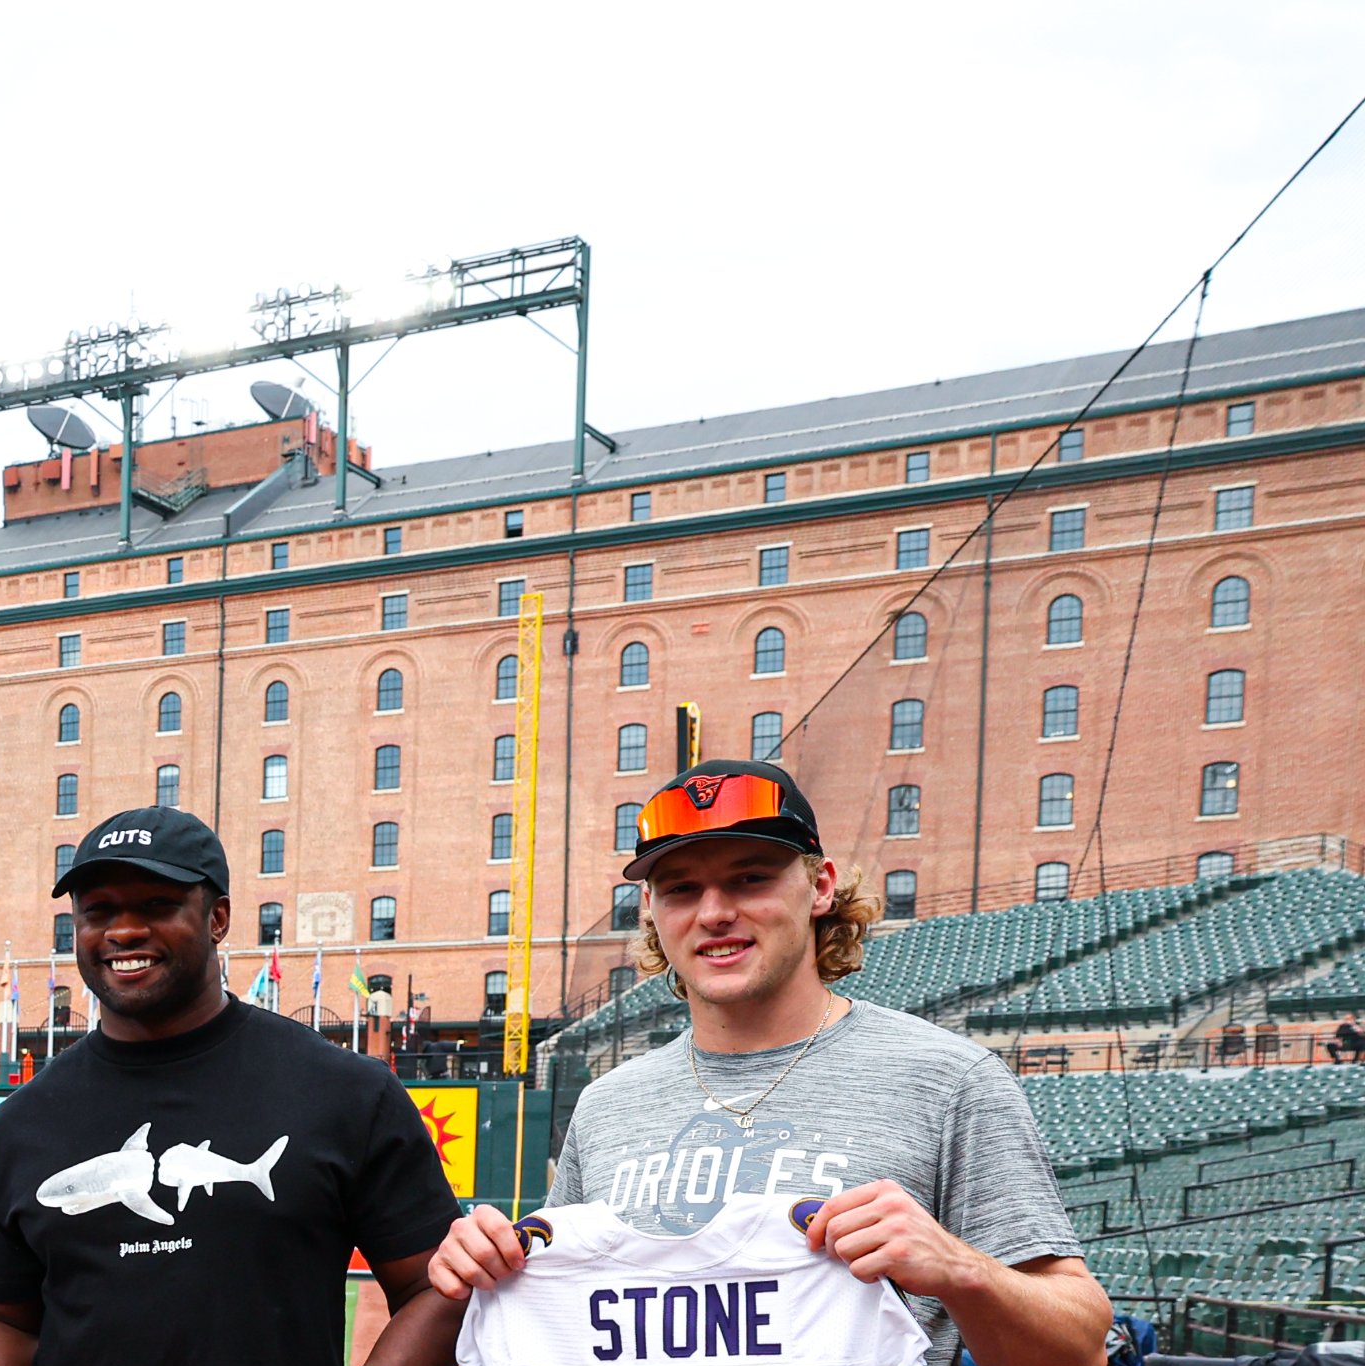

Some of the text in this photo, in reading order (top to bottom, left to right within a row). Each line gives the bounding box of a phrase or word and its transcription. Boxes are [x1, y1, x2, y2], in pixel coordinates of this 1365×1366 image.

[97, 828, 152, 849] CUTS
[610, 1146, 849, 1212] ORIOLES
[152, 1235, 193, 1254] Angels
[590, 1280, 782, 1361] STONE
